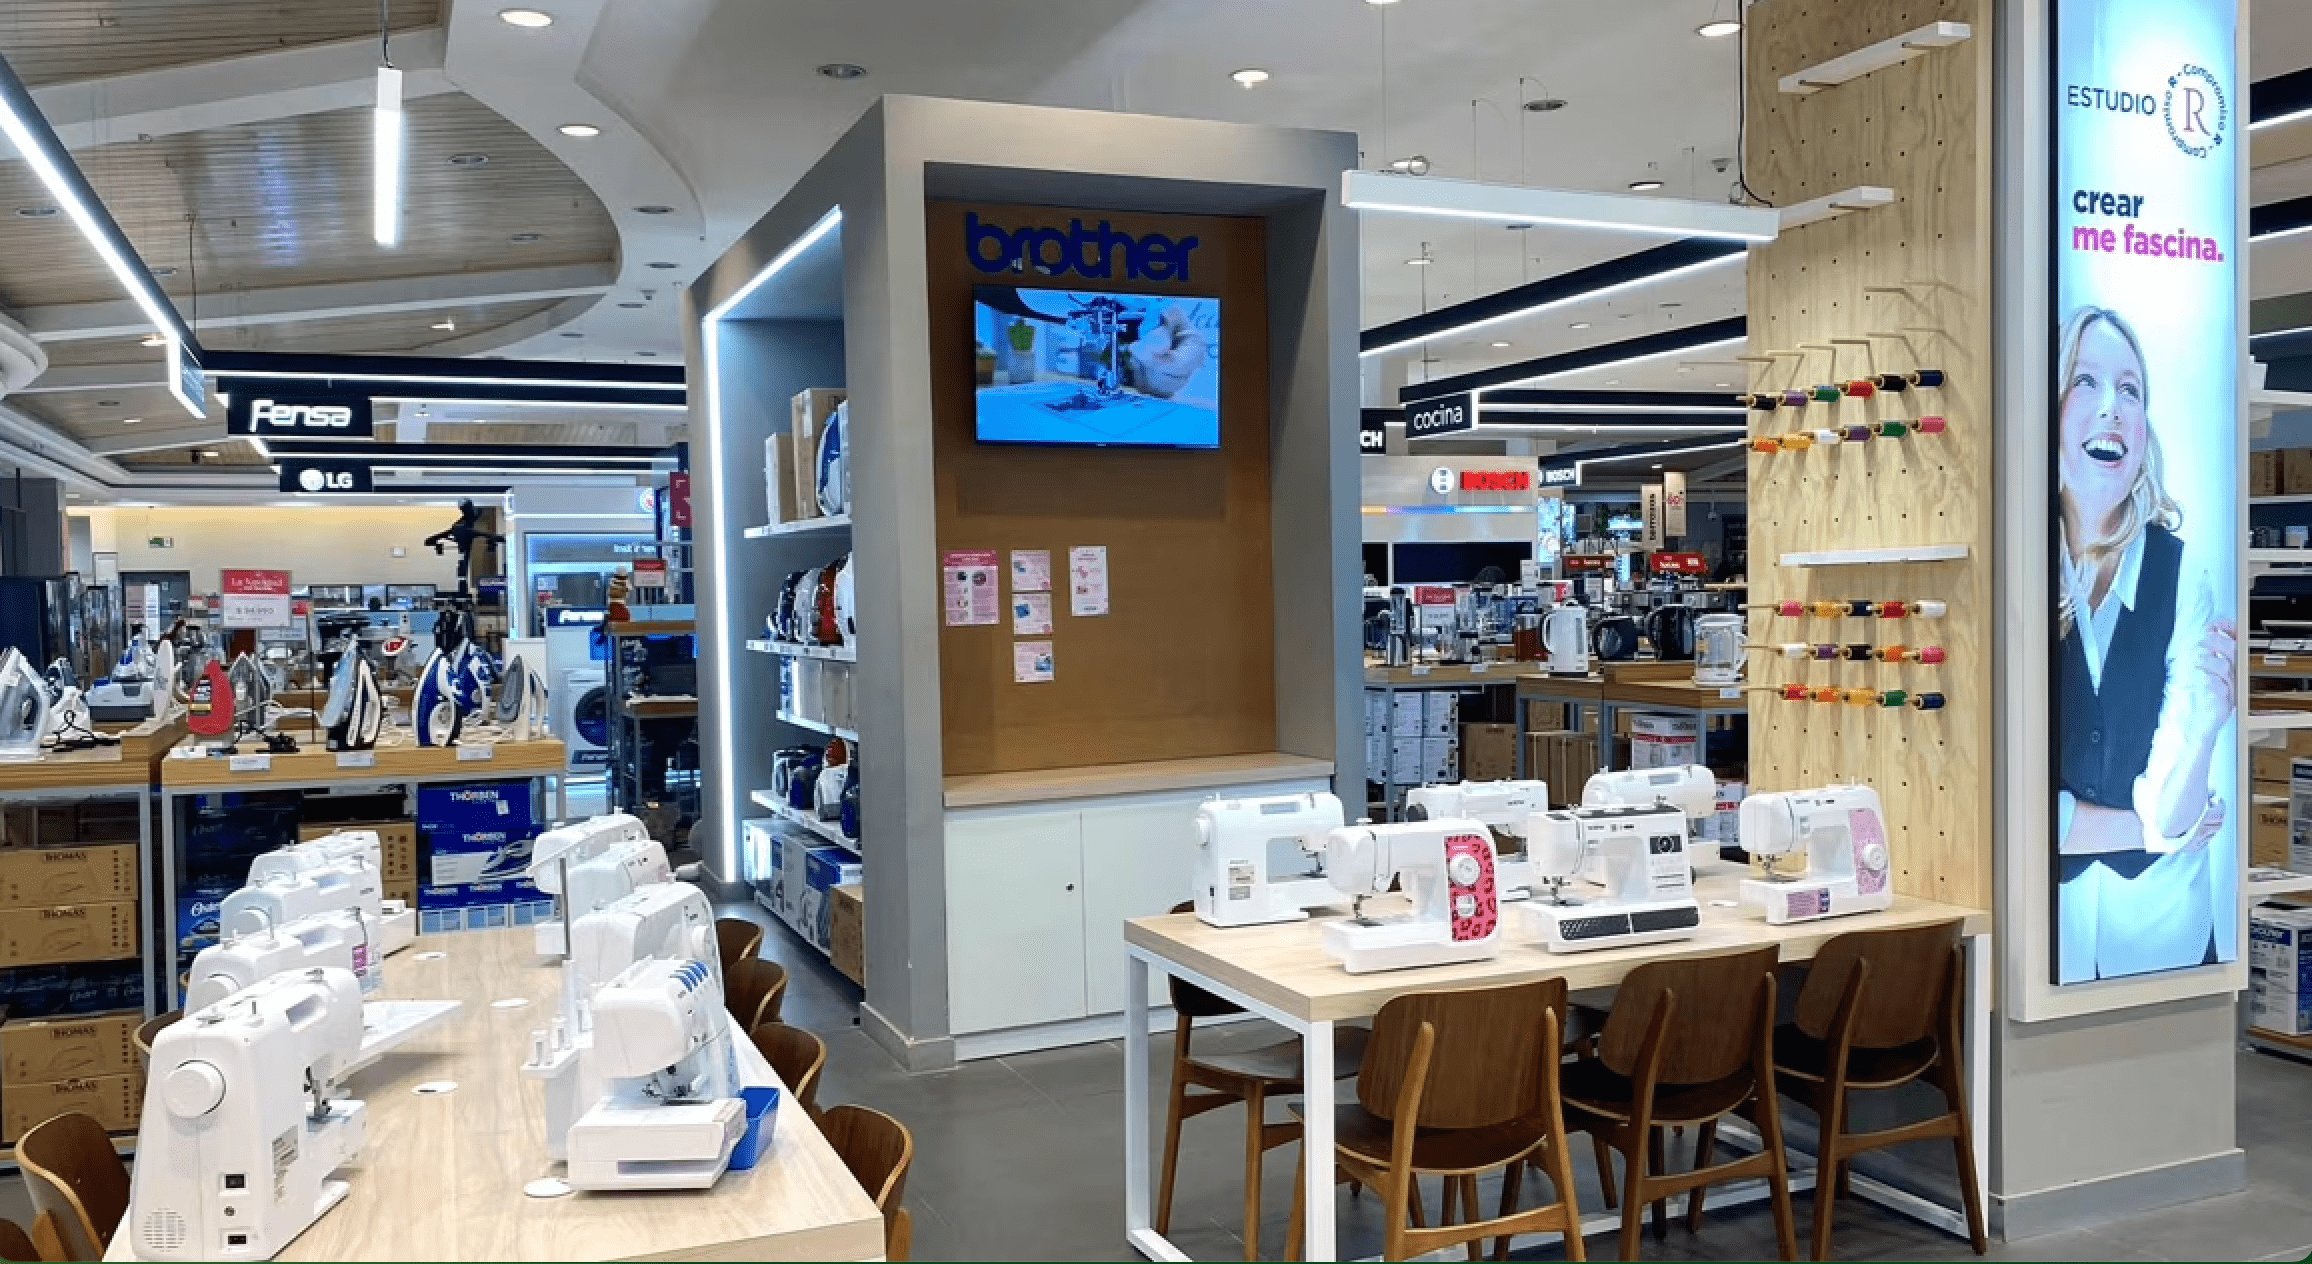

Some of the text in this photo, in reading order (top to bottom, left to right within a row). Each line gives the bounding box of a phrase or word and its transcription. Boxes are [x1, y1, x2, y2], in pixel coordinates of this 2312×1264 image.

[2067, 84, 2157, 117] ESTUDIO
[2182, 86, 2212, 138] R
[2072, 189, 2144, 218] crear
[964, 210, 1199, 282] brother
[2072, 223, 2224, 262] me fascina.
[1413, 403, 1464, 431] cocina
[325, 471, 354, 489] LG
